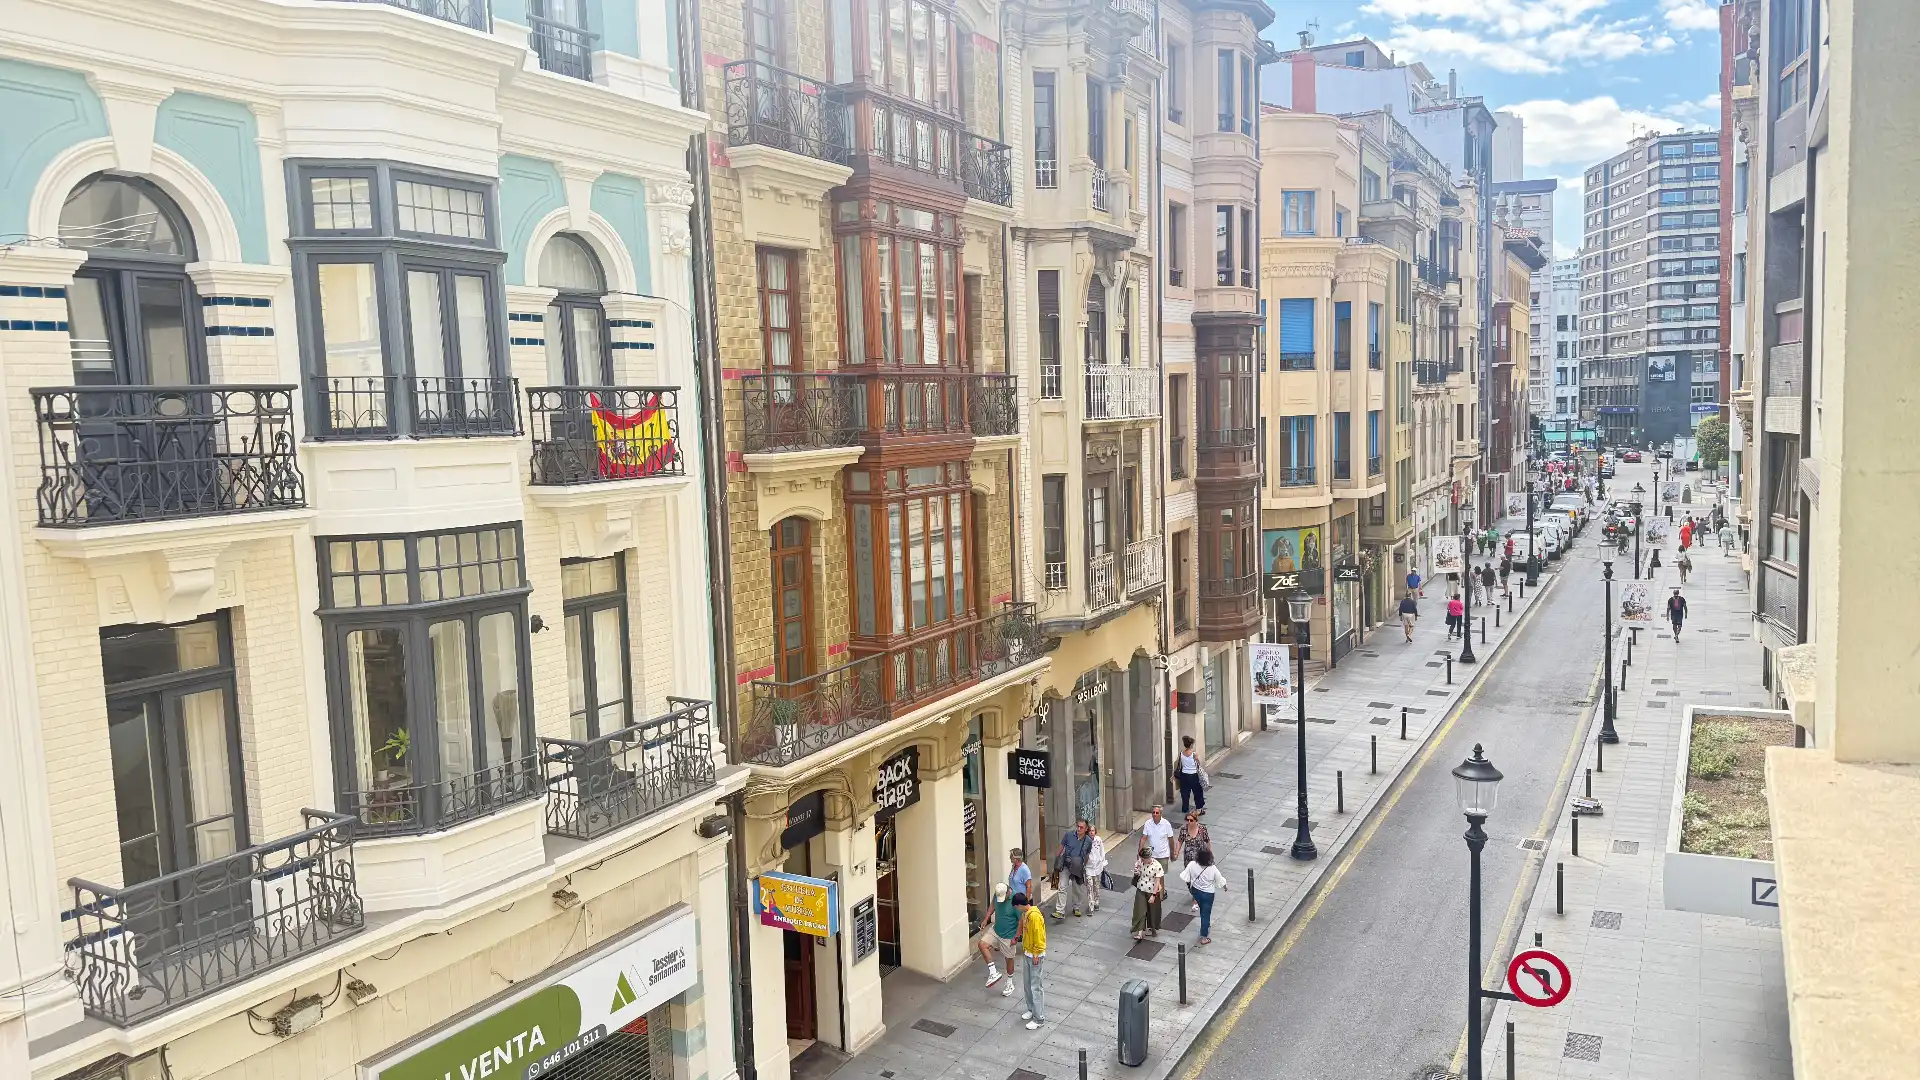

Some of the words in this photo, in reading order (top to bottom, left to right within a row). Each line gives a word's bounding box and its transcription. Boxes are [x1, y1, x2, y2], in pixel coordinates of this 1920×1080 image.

[876, 755, 912, 791] BACK
[1019, 756, 1045, 768] BACK
[1019, 765, 1046, 779] stage
[876, 779, 913, 811] stage
[652, 949, 678, 974] Tessier
[459, 1024, 546, 1080] VENTA
[543, 1053, 561, 1070] 646
[563, 1042, 581, 1058] 101
[583, 1029, 601, 1046] 811
